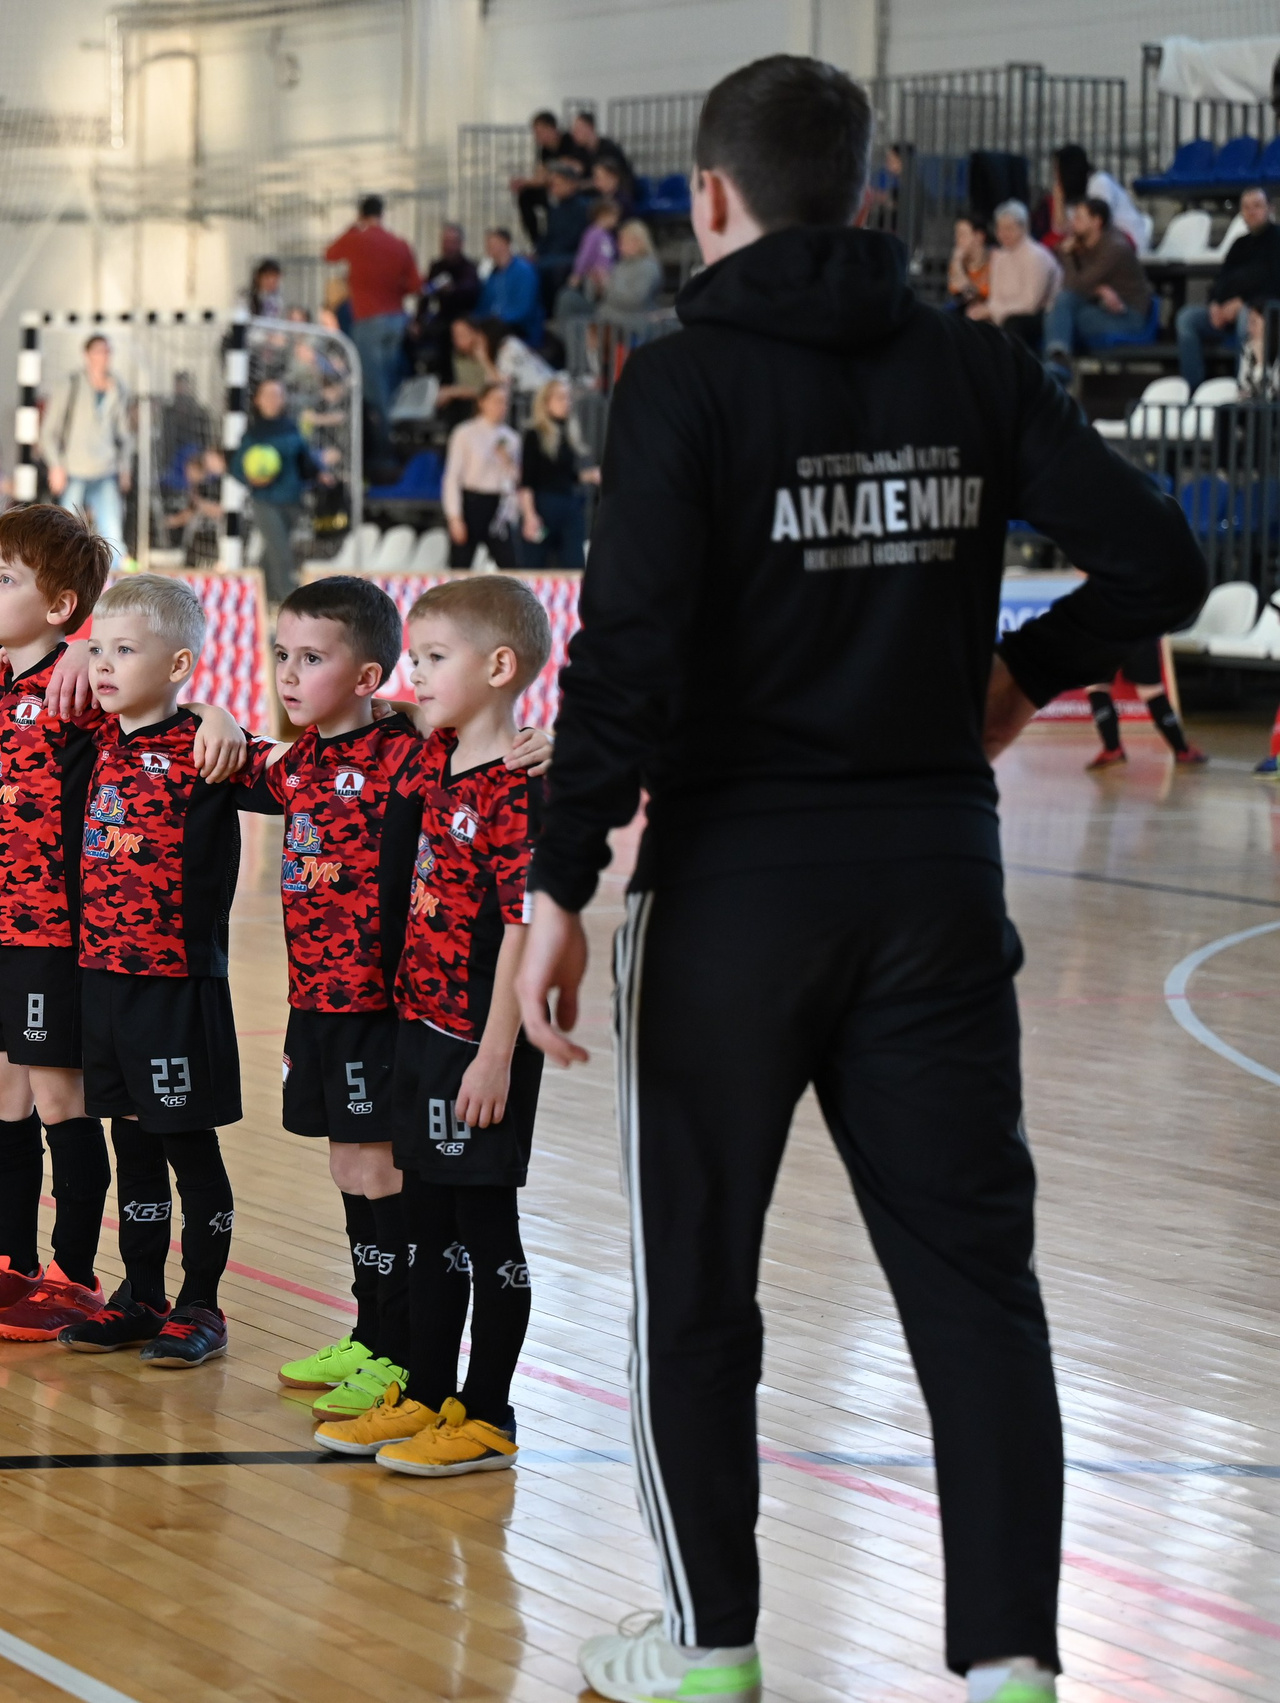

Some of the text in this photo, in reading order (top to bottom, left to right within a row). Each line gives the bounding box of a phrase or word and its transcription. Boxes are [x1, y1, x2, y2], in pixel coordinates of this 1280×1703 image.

[772, 477, 983, 541] АКАДЕМИЯ
[27, 993, 44, 1027] 8
[150, 1057, 191, 1093] 23
[345, 1061, 367, 1100] 5
